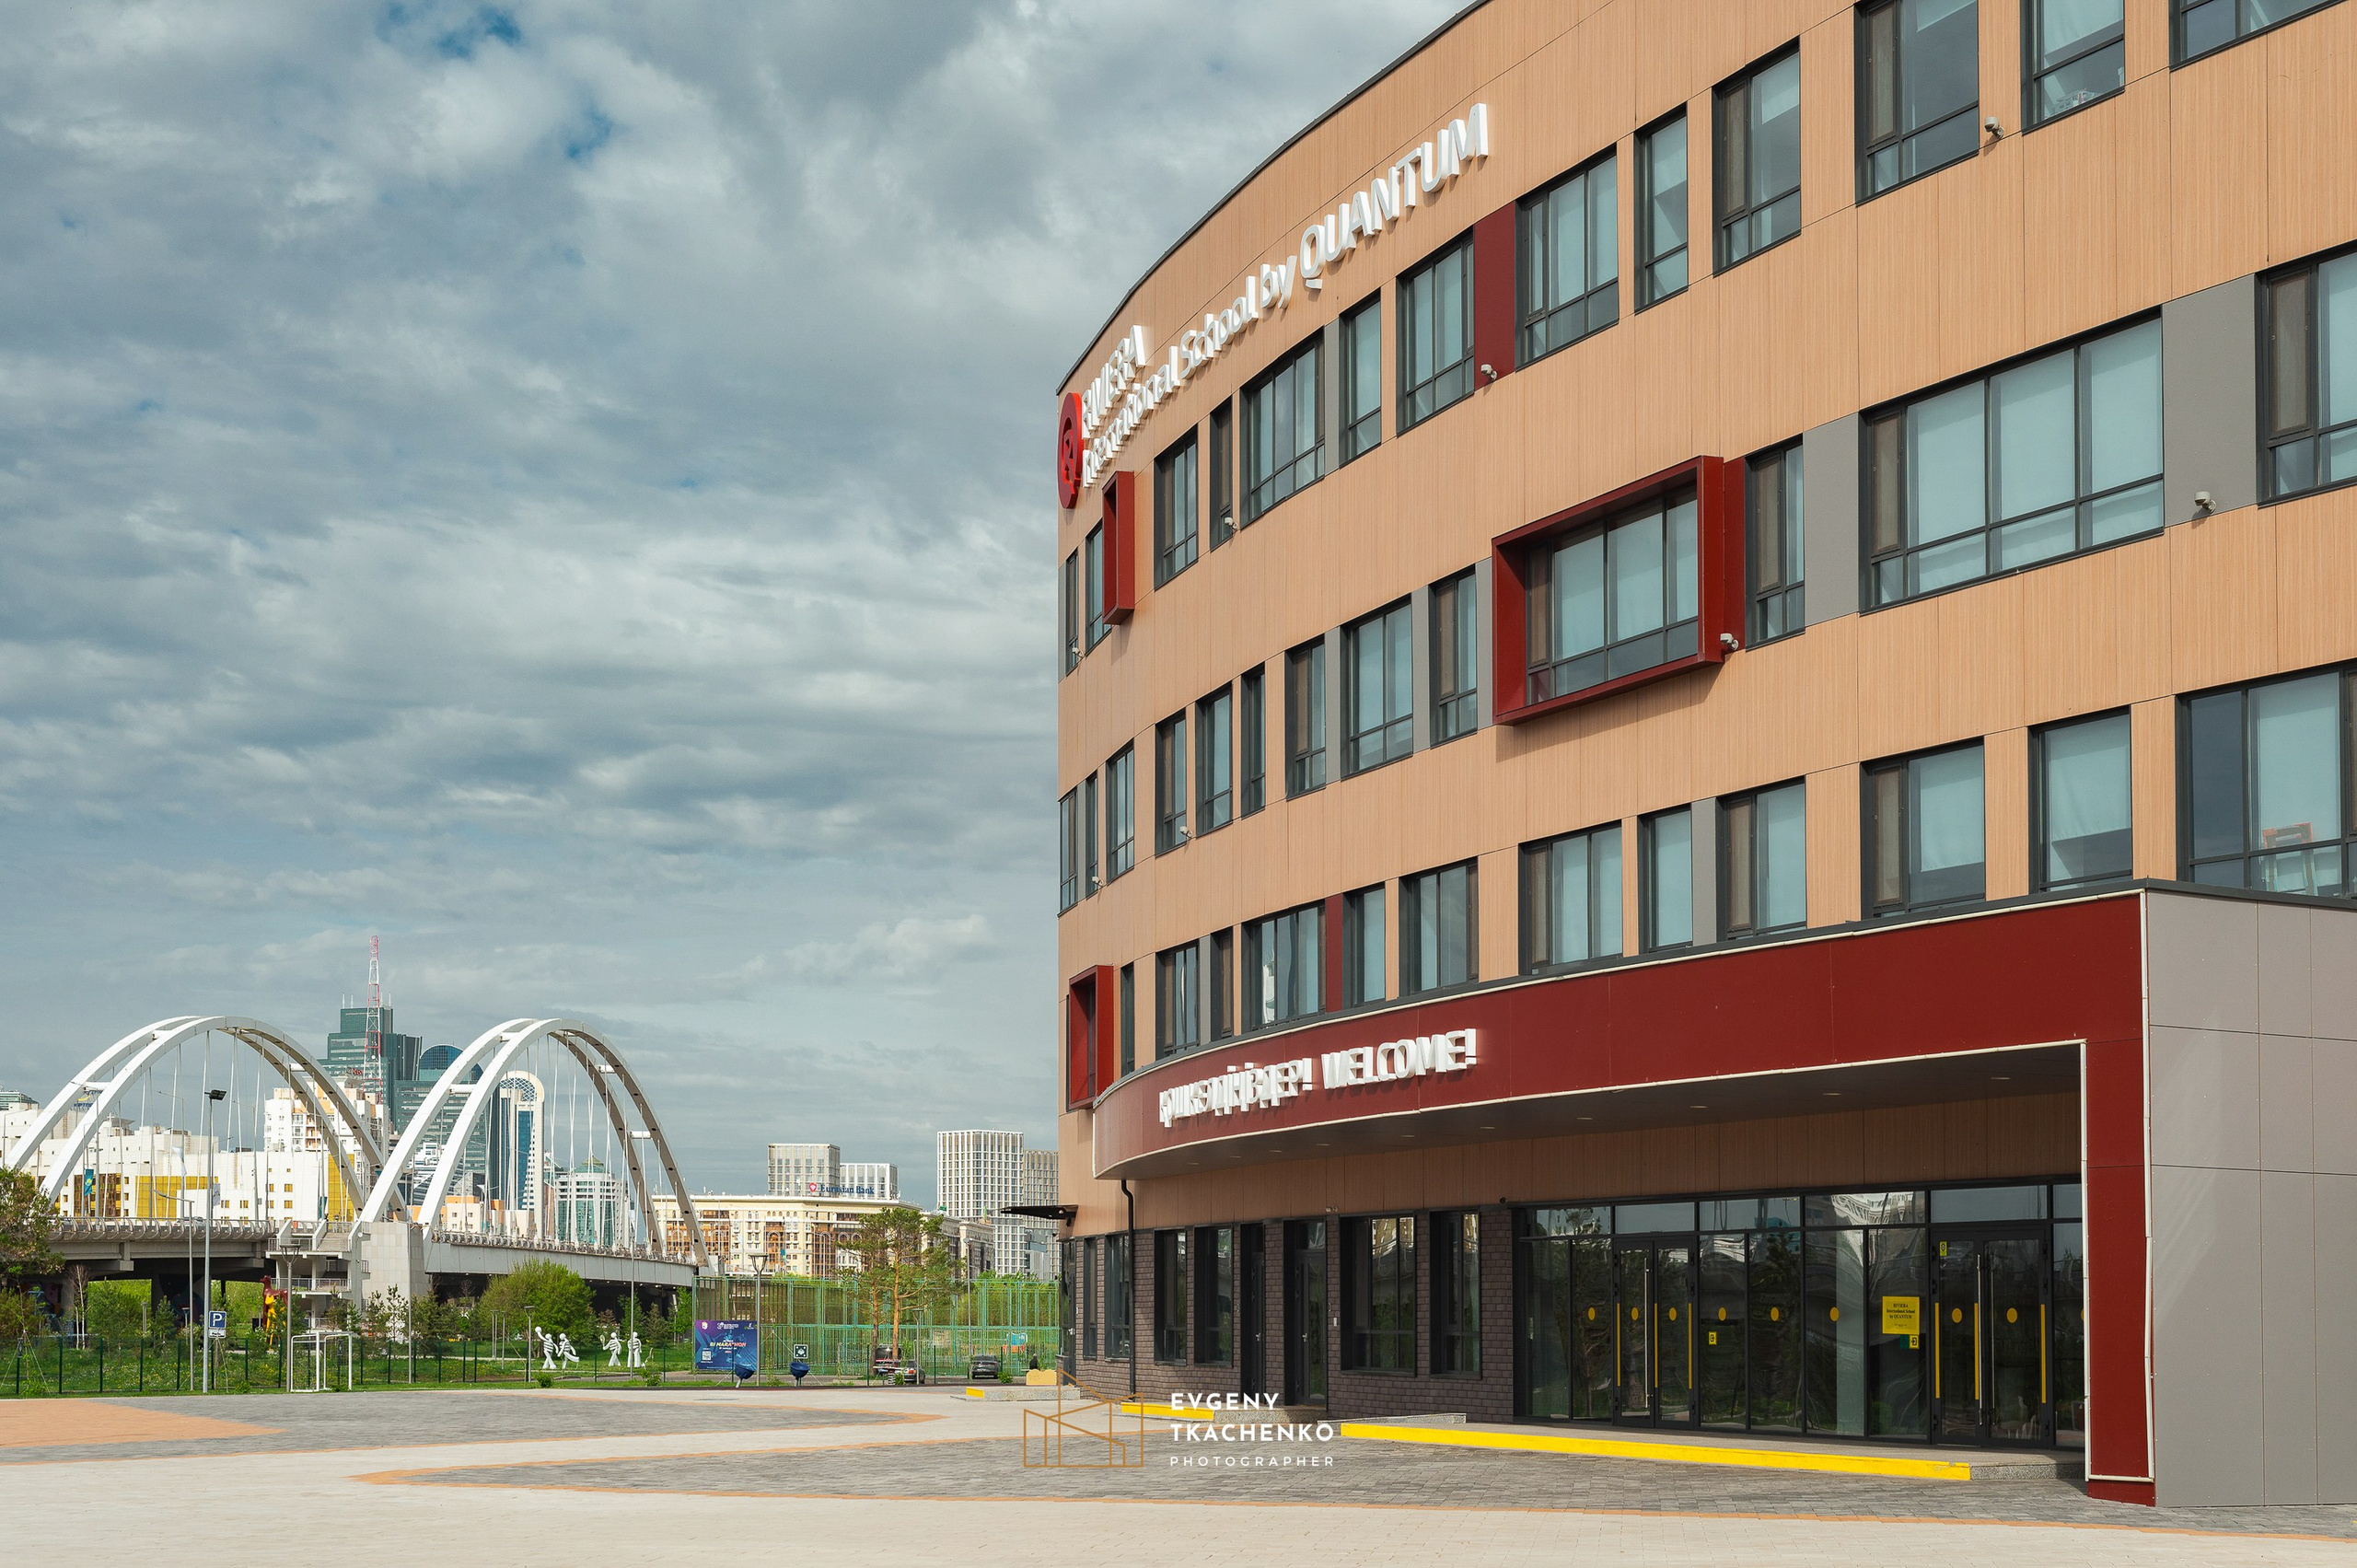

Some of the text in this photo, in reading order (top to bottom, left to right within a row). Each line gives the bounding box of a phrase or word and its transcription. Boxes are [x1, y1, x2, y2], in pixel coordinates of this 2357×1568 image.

[1179, 276, 1260, 380] School
[1260, 256, 1297, 309] by
[1299, 103, 1488, 290] QUANTUM
[1321, 1028, 1477, 1090] WELCOME!
[820, 1184, 875, 1194] Eurasian Bank
[212, 1313, 223, 1327] P
